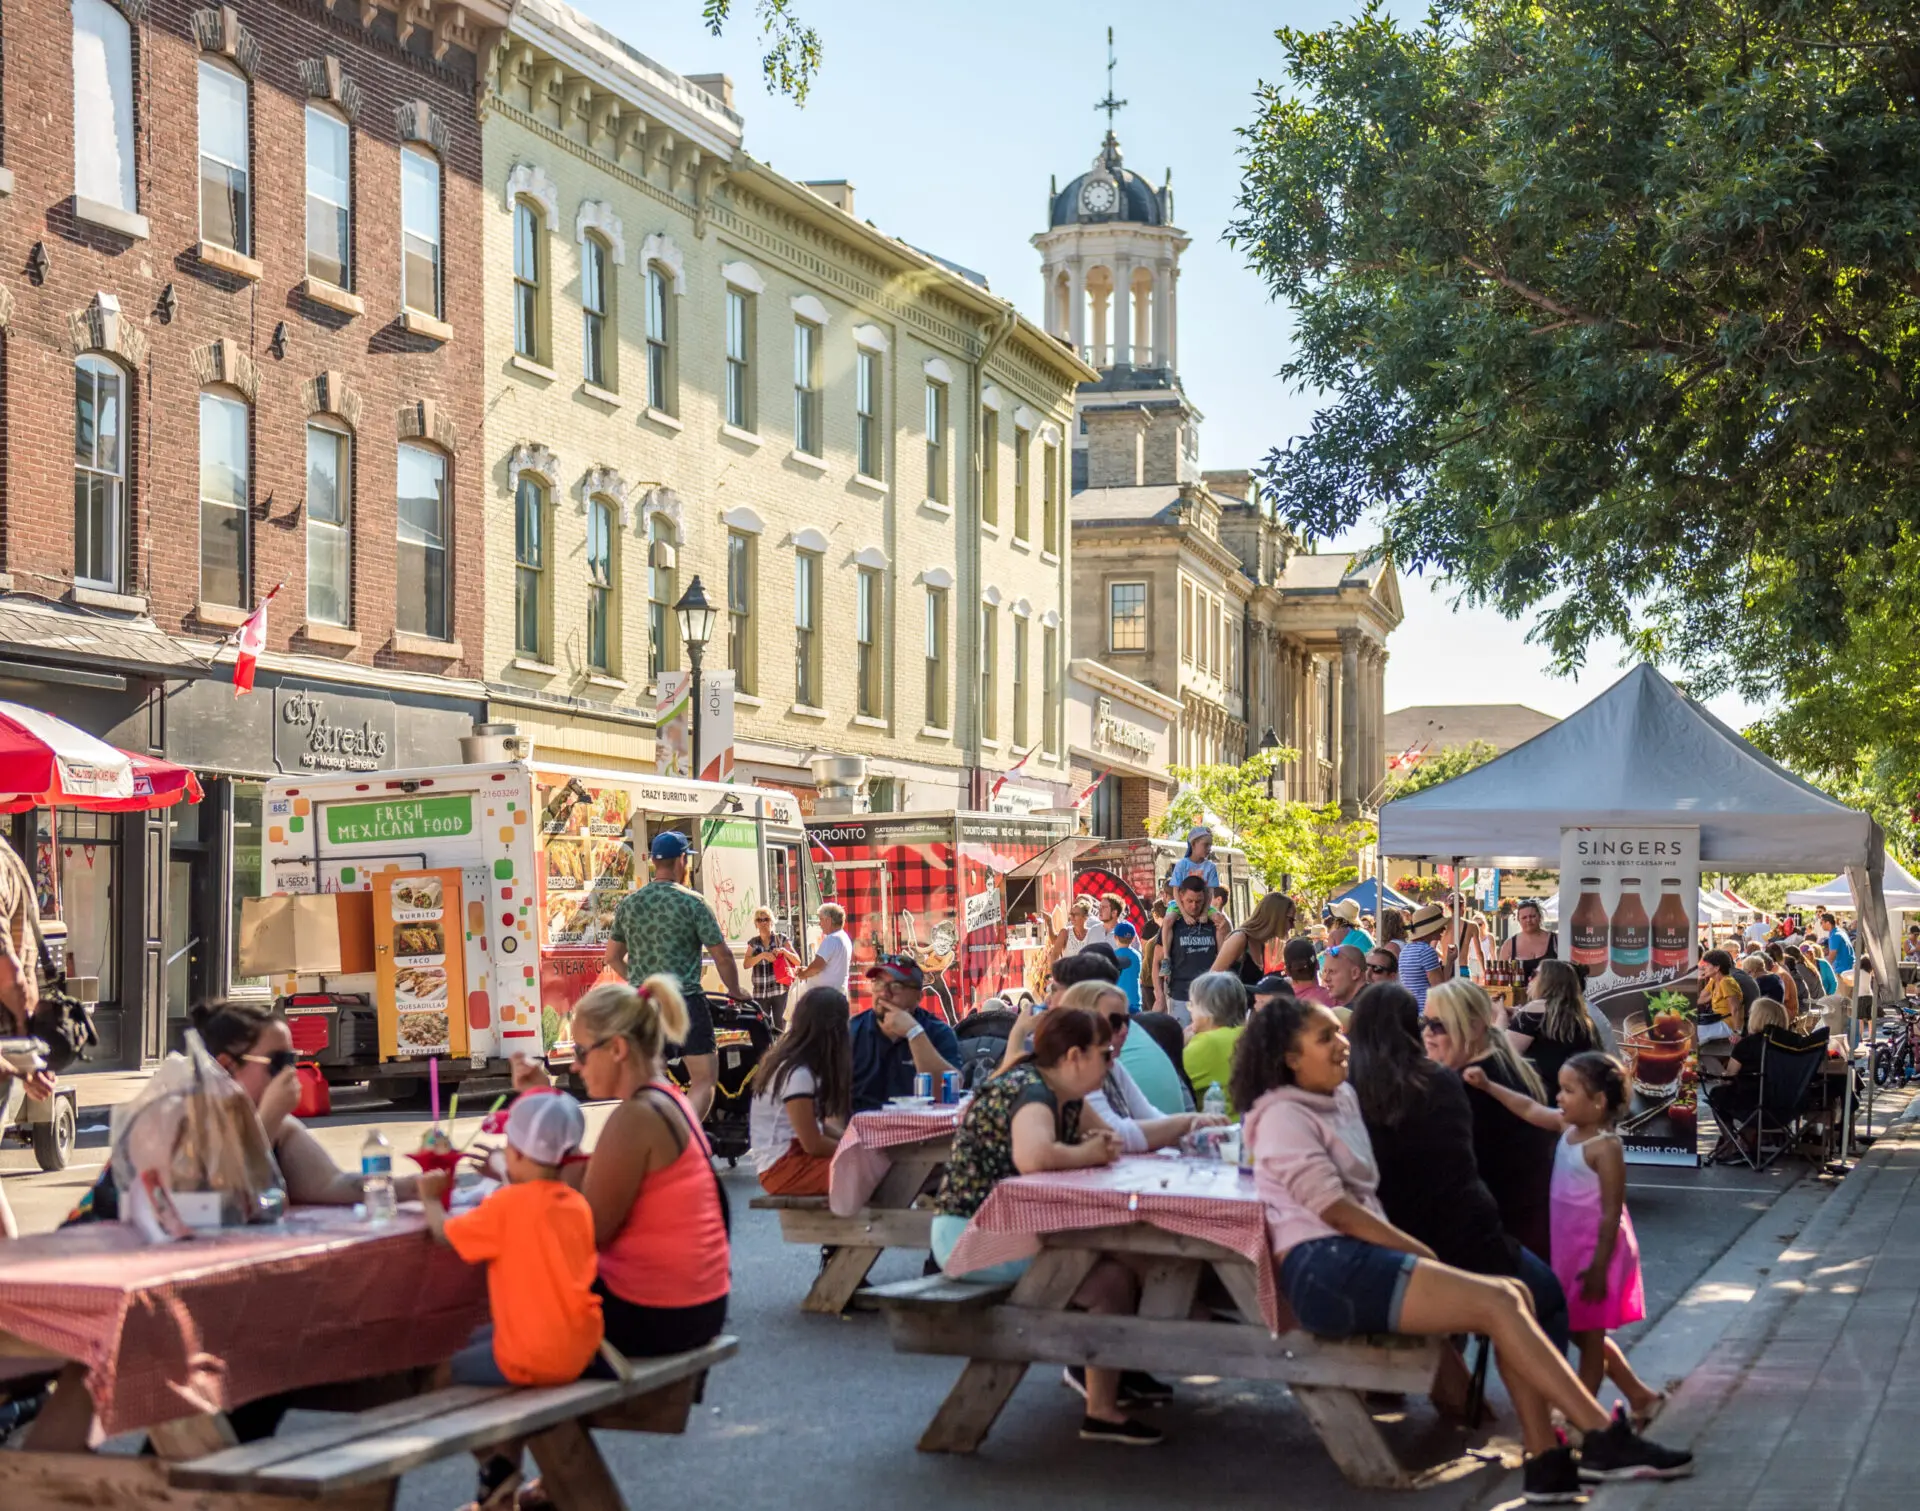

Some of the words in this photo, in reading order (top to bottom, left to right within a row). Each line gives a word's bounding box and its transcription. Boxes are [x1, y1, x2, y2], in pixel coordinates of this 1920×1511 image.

[665, 682, 676, 706] EAT
[709, 680, 721, 717] SHOP
[482, 788, 520, 799] 21603269
[641, 789, 661, 800] CRAZY
[662, 790, 687, 802] BURRITO
[688, 792, 699, 803] INC
[375, 803, 424, 822] FRESH
[337, 820, 415, 841] MEXICAN
[423, 816, 463, 834] FOOD
[874, 825, 904, 834] CATERING
[805, 827, 867, 842] TORONTO
[1577, 840, 1682, 856] SINGERS
[1617, 859, 1635, 867] BEST
[399, 911, 437, 920] BURRITO
[967, 906, 1001, 929] POUTINERIE
[1574, 935, 1606, 943] SINGERS
[1614, 936, 1647, 944] SINGERS
[1655, 936, 1687, 944] SINGERS
[408, 957, 431, 965] TACO
[552, 959, 587, 975] STEAK
[398, 1001, 446, 1011] QUESADILLAS
[400, 1047, 425, 1056] CRAZY
[1622, 1144, 1689, 1155] ERSMIX.COM
